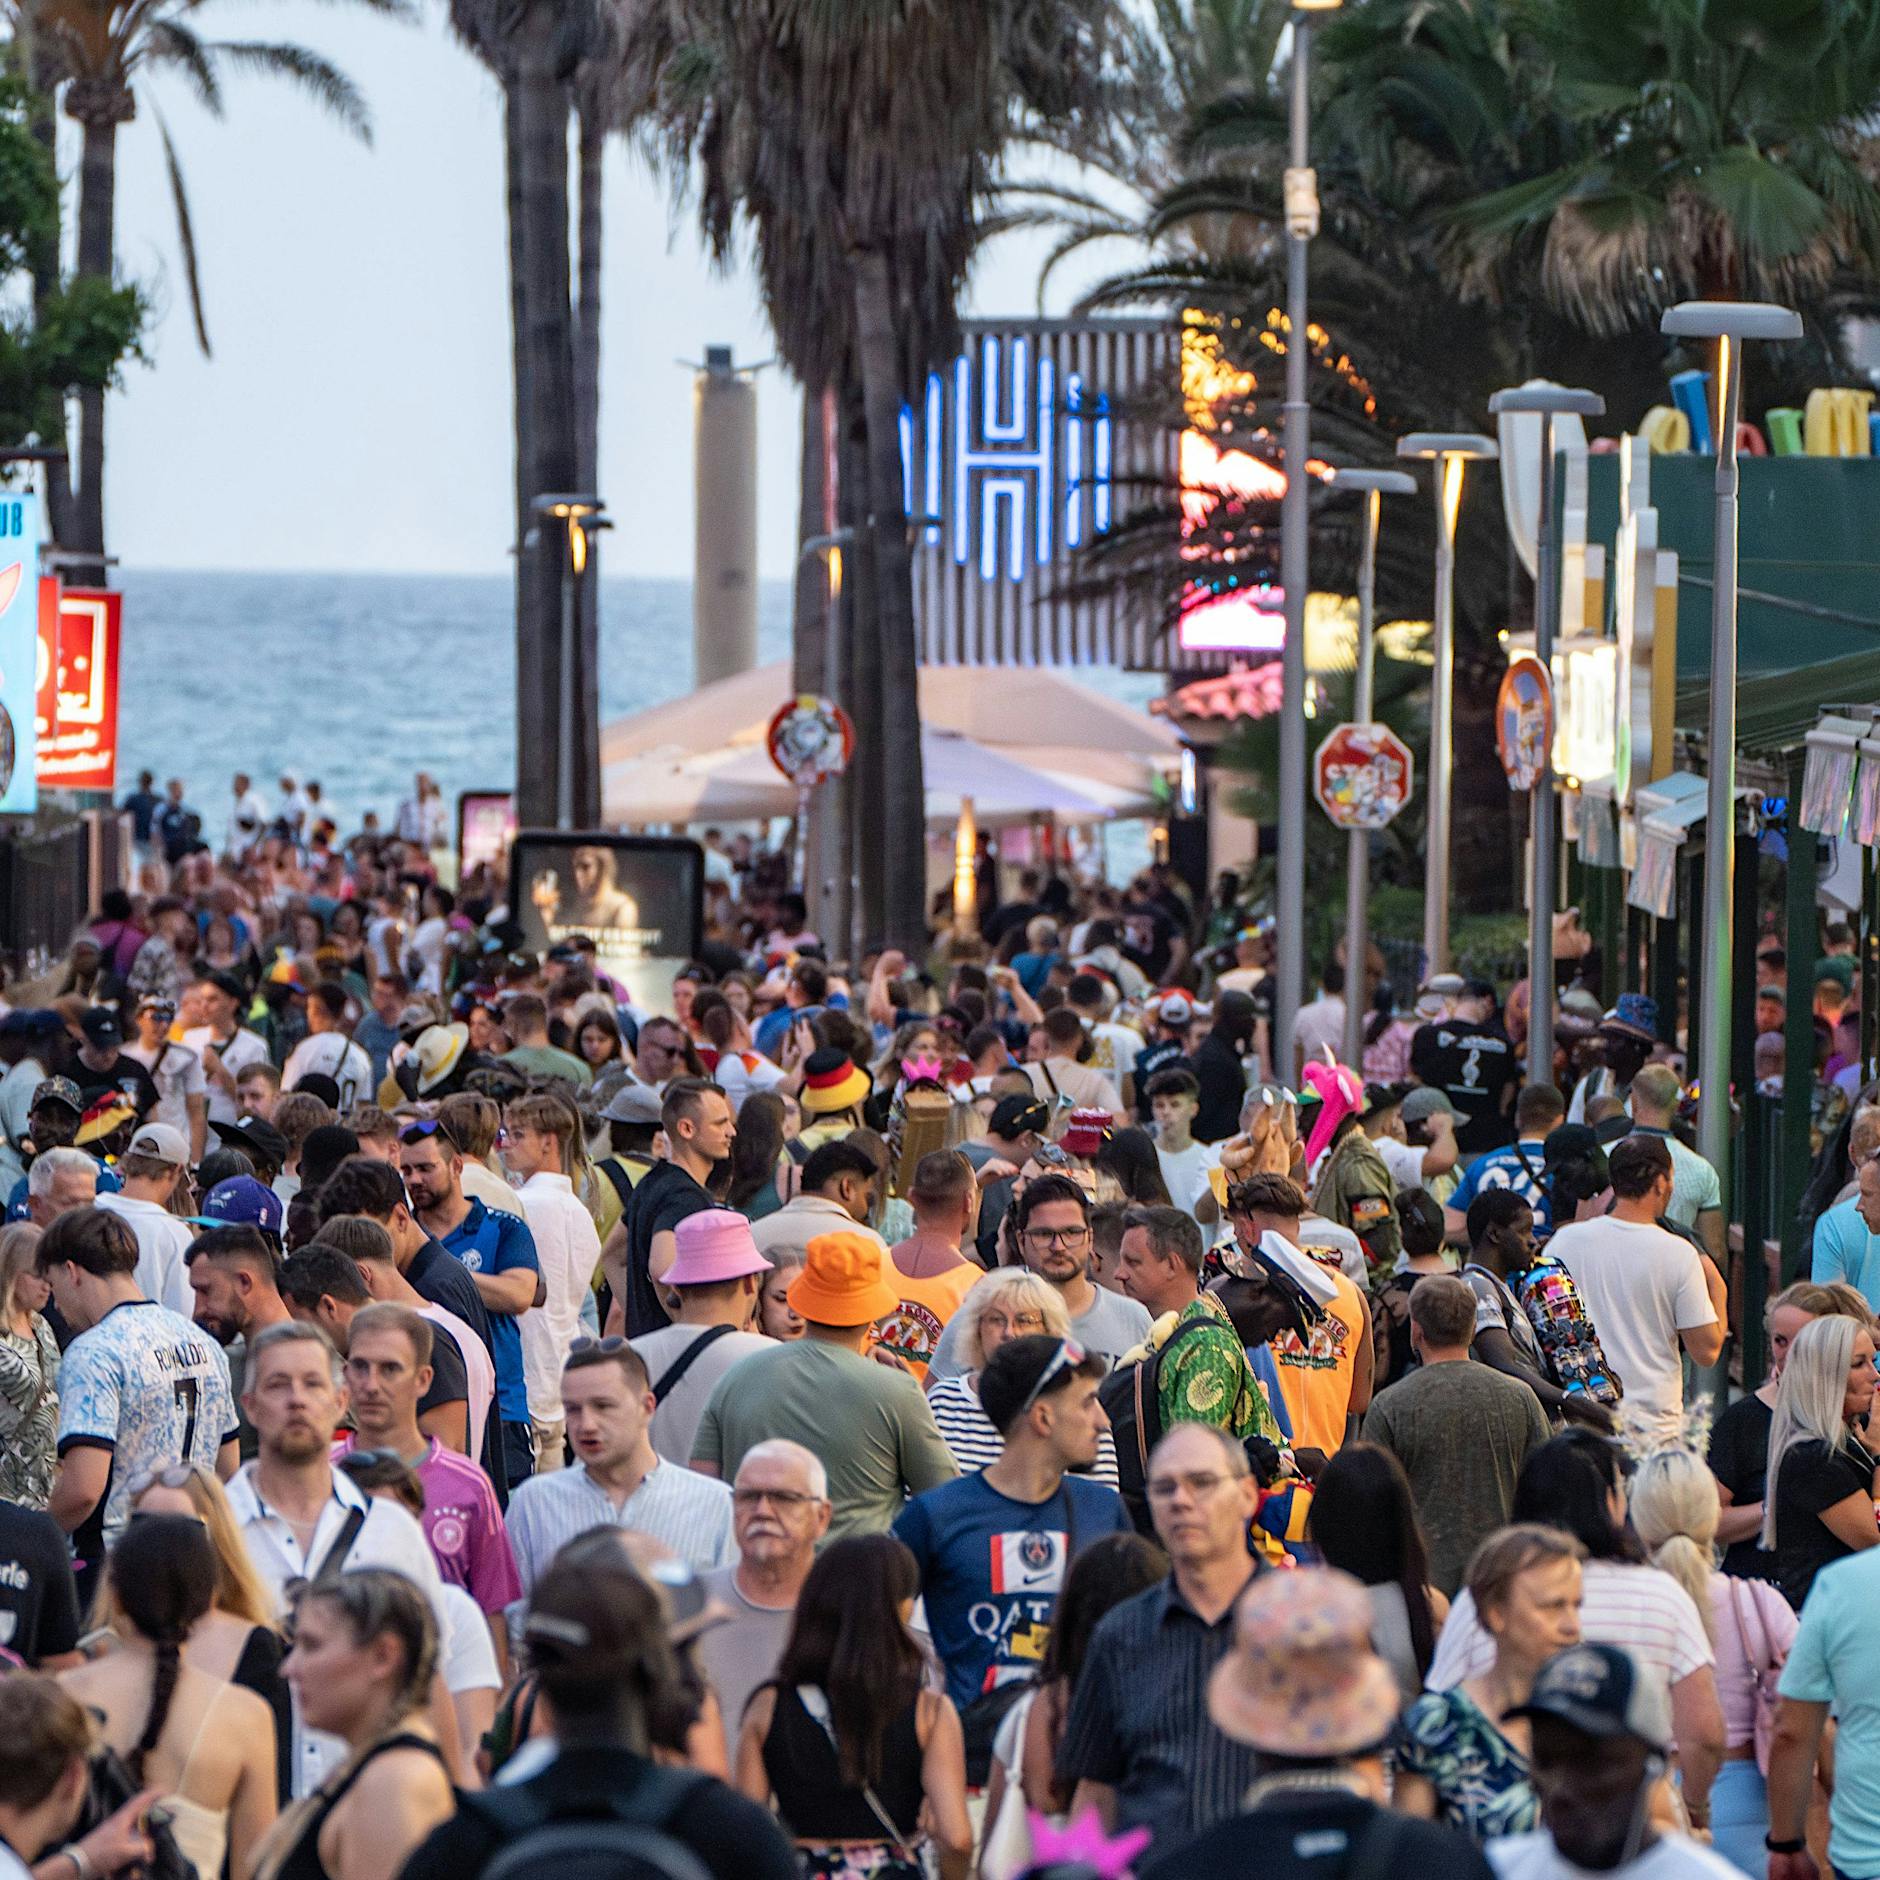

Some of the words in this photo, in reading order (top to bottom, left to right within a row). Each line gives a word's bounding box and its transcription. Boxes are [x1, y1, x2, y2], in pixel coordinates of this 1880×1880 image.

[0, 502, 22, 537] UB
[154, 1344, 208, 1371] RONALDO
[173, 1377, 200, 1464] 7
[0, 1560, 29, 1589] rle
[967, 1600, 1050, 1642] QAT
